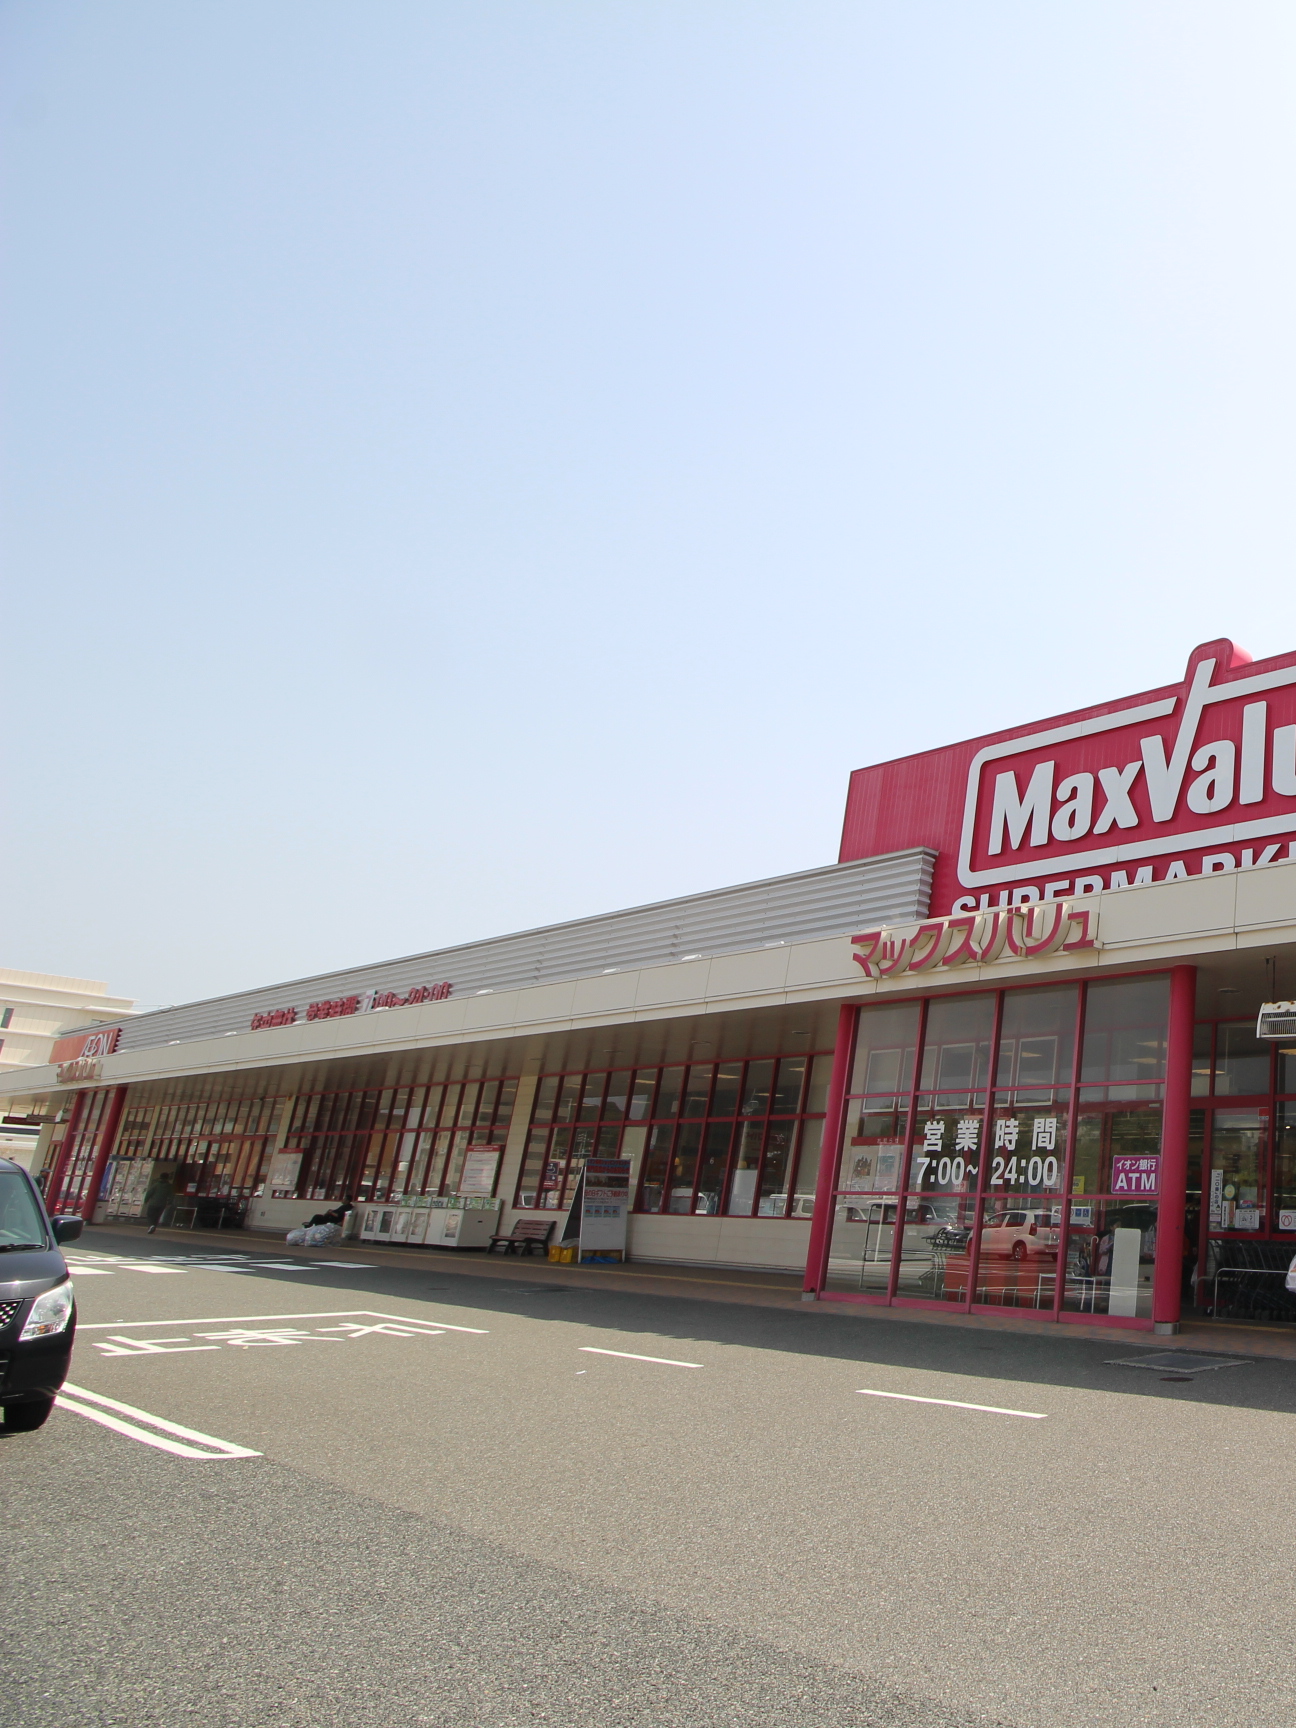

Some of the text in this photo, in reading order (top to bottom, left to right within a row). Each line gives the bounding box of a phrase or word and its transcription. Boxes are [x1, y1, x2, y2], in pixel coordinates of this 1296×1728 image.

[850, 902, 1096, 978] マックスバリュ
[306, 995, 359, 1021] 営業時間
[922, 1117, 1057, 1152] 営業時間
[1116, 1159, 1157, 1171] イオン銀行
[1115, 1173, 1156, 1190] ATM
[91, 1322, 447, 1357] 止まれ
